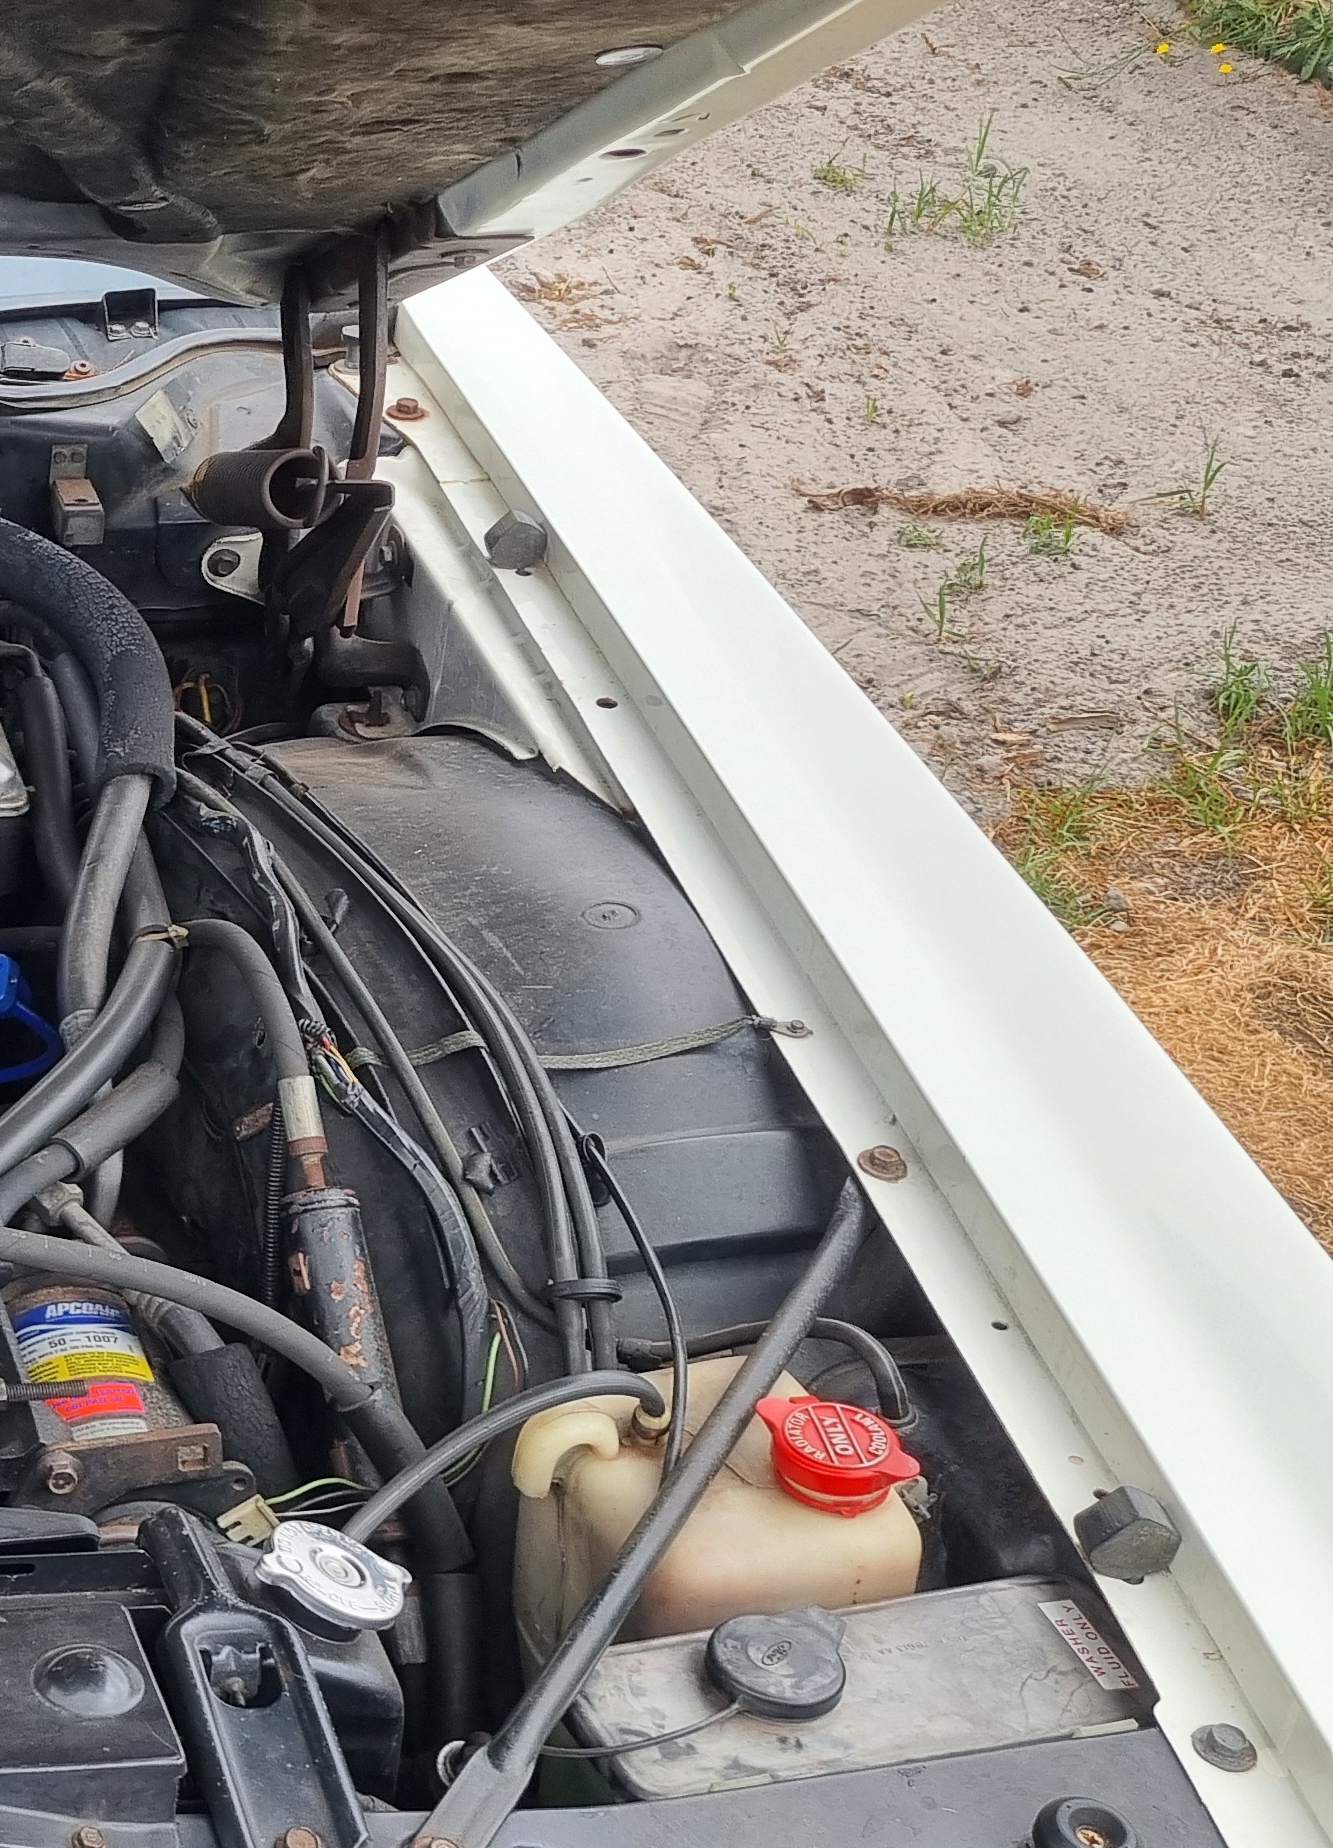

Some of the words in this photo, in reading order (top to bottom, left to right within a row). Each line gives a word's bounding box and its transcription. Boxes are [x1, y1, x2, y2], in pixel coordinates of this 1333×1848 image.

[787, 1412, 827, 1461] RADIATOR
[819, 1415, 855, 1456] ONLY
[853, 1413, 887, 1456] COOLANT
[1062, 1604, 1099, 1642] ONLY
[1054, 1618, 1107, 1677] WASHER
[1096, 1646, 1136, 1688] FLUID
